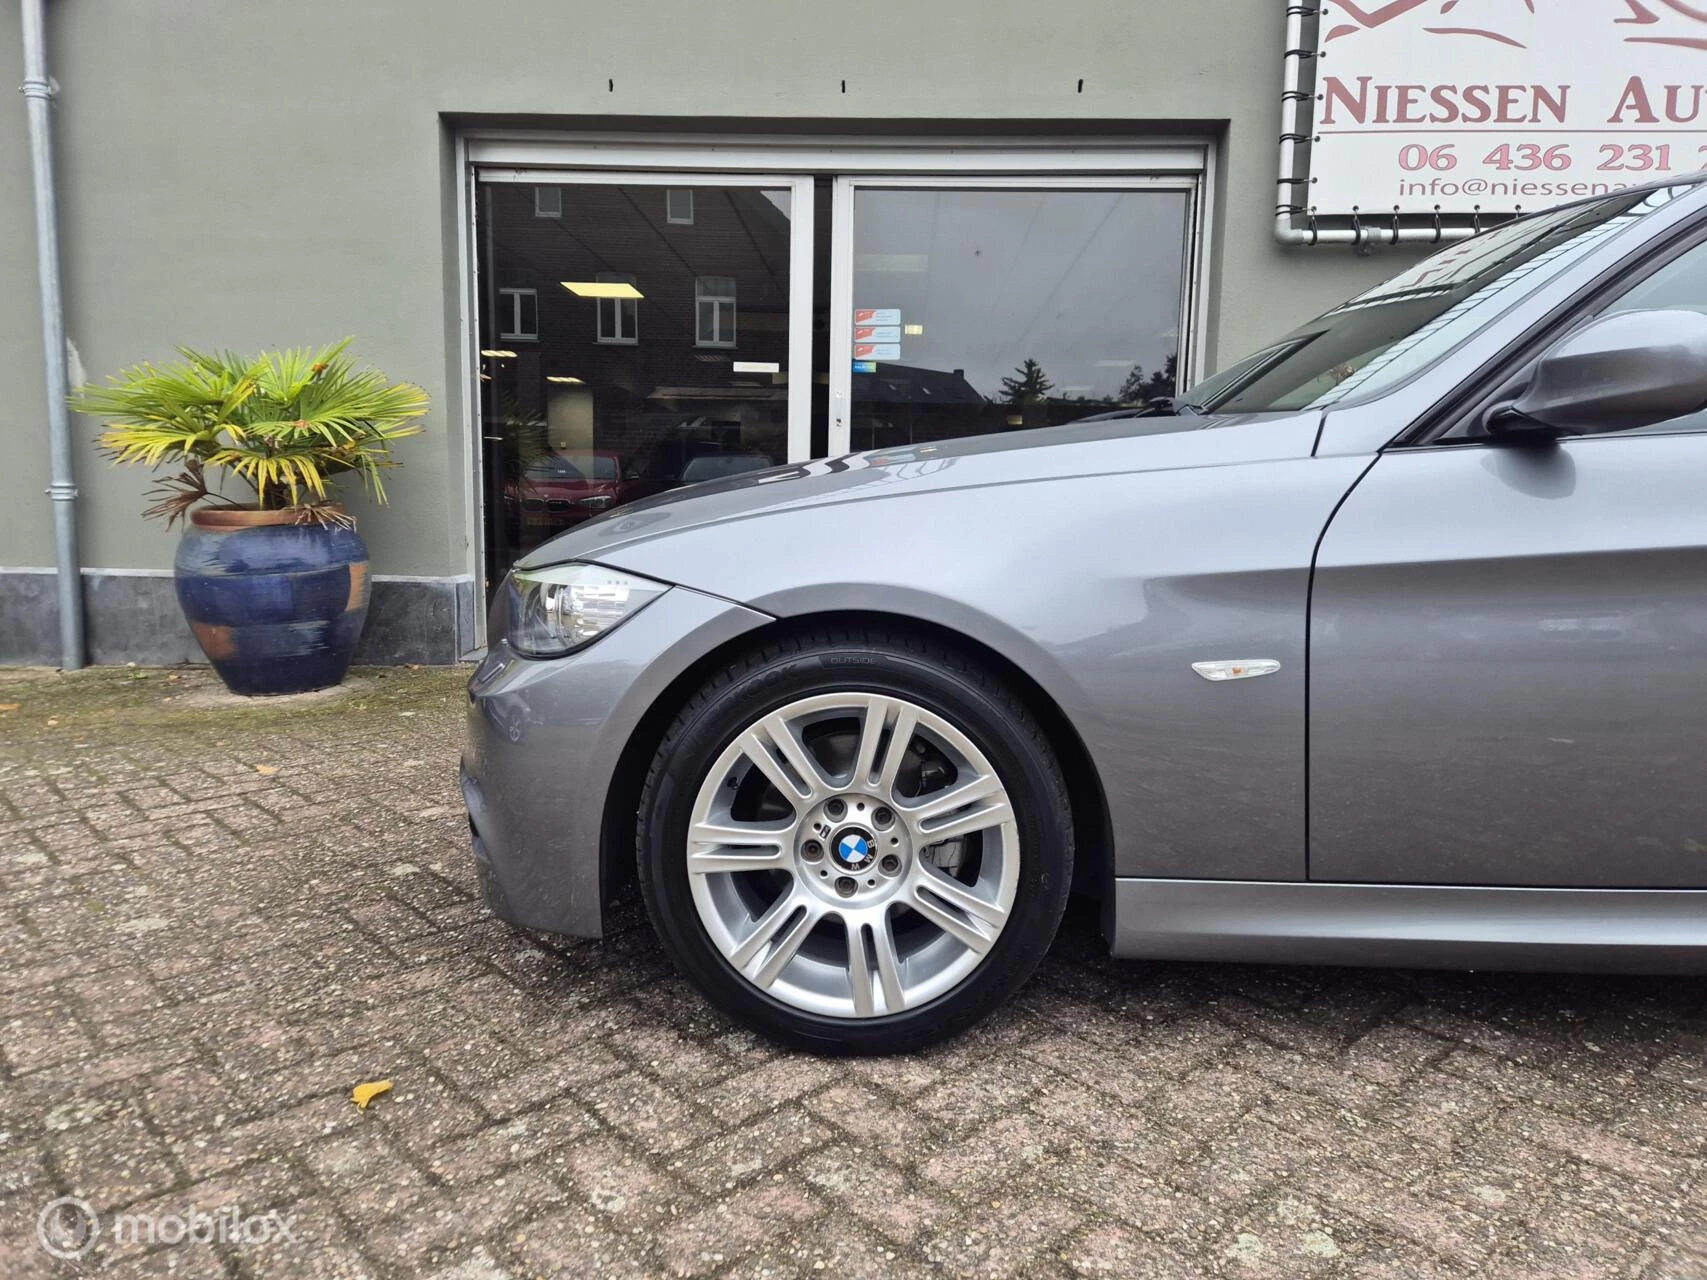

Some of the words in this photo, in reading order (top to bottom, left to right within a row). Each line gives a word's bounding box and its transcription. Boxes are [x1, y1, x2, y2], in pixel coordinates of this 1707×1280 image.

[1320, 76, 1571, 124] NIESSEN
[1606, 75, 1707, 123] AU
[1398, 143, 1458, 171] 06
[1482, 143, 1572, 171] 436
[1596, 143, 1671, 171] 231
